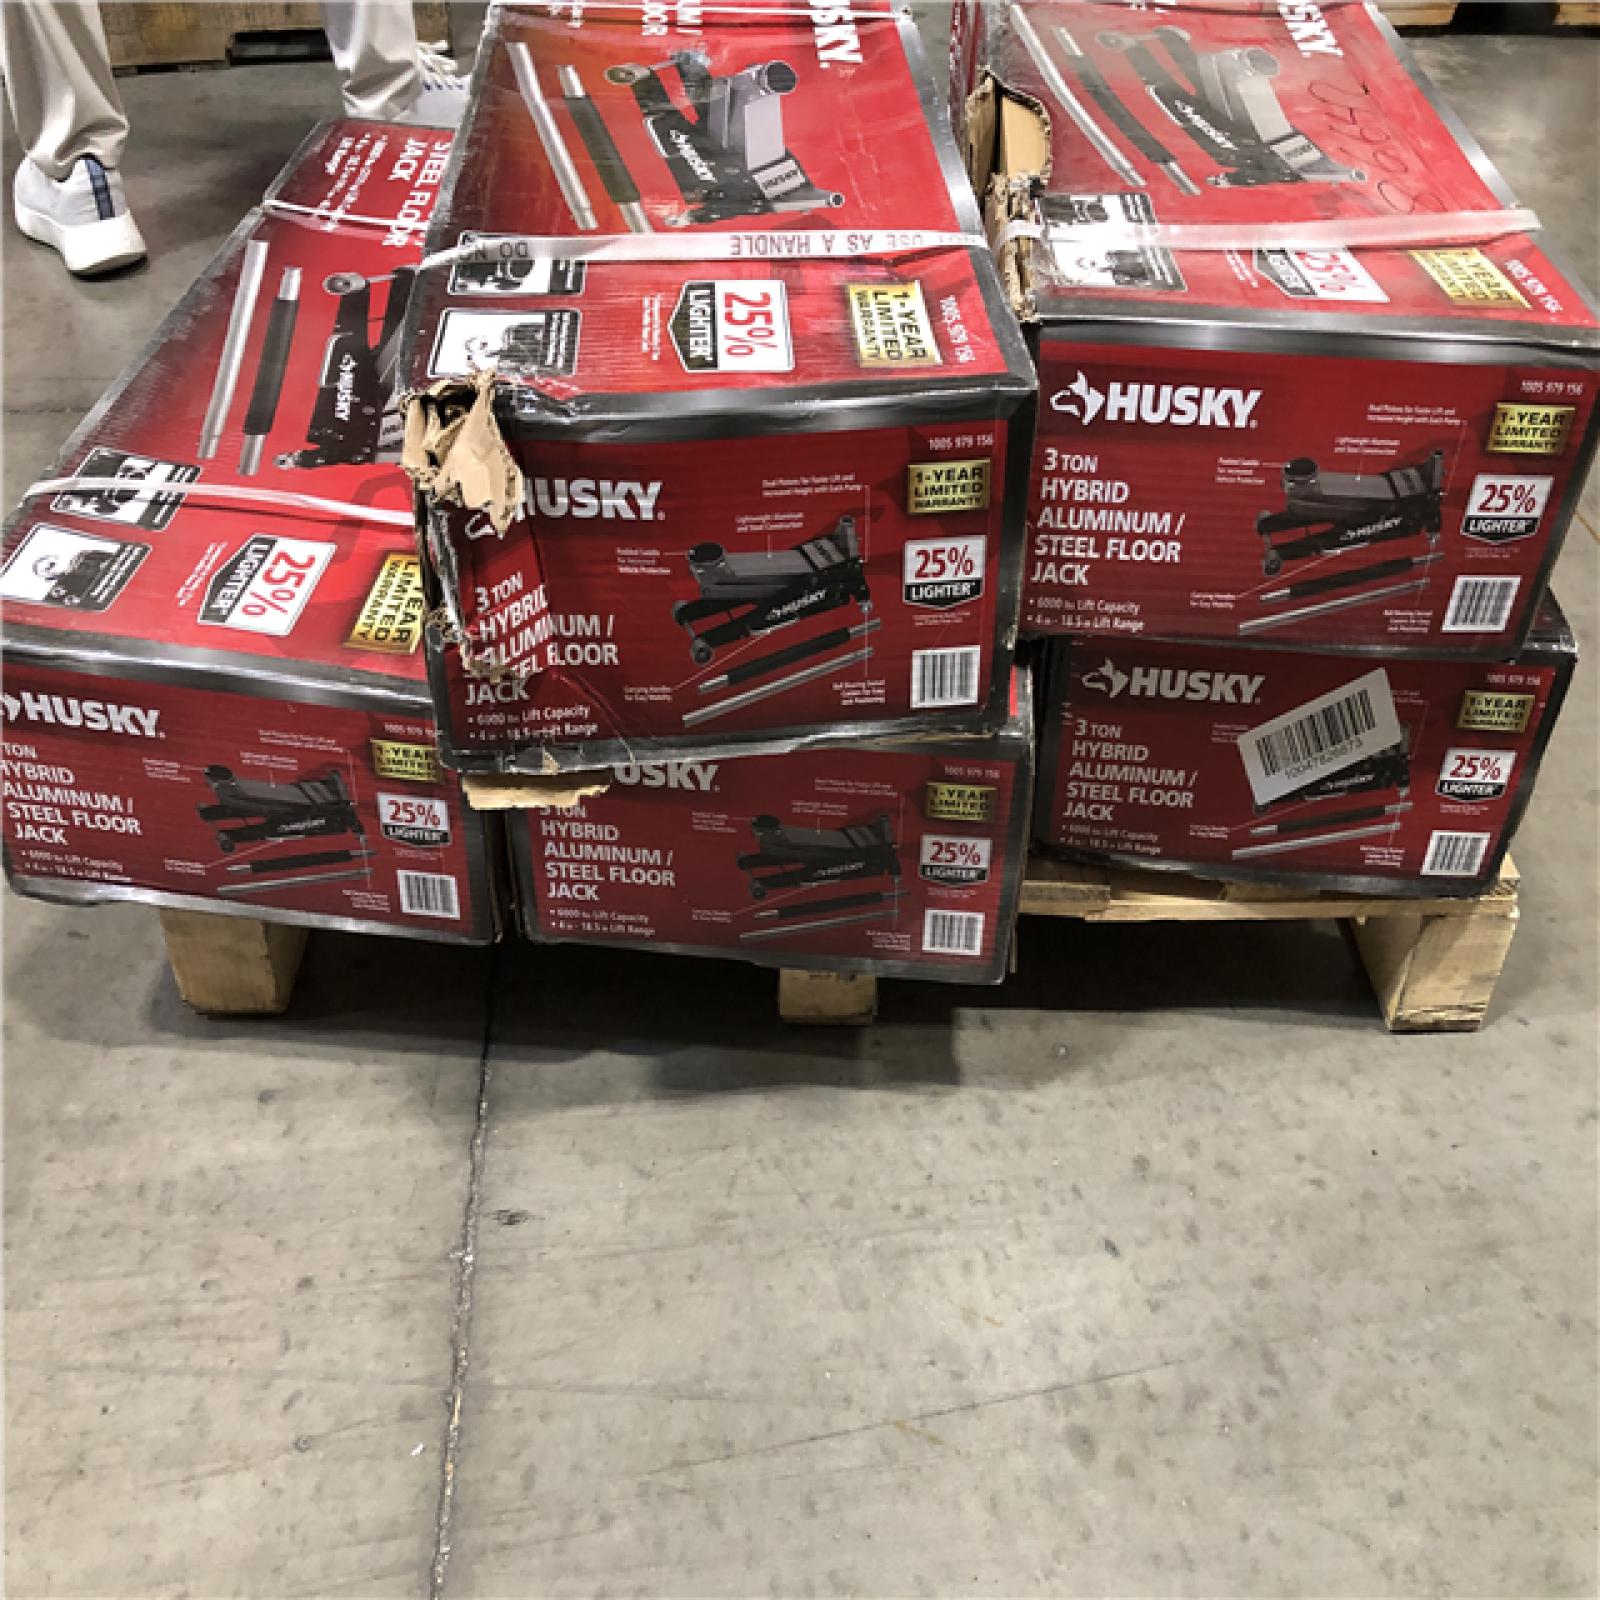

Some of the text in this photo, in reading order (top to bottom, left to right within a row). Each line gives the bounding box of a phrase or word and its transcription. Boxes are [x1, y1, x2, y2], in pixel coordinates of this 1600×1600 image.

[811, 0, 863, 61] SKY
[1278, 0, 1343, 56] SKY
[729, 234, 810, 256] HANDLE
[822, 234, 836, 253] A
[847, 233, 874, 252] AS
[689, 289, 713, 362] LIGHTER
[721, 291, 779, 357] 25%
[872, 290, 903, 362] LIMITED
[890, 290, 929, 361] 1-YEAR
[1105, 382, 1263, 428] HUSKY
[1499, 411, 1566, 426] 1-YEAR
[1495, 427, 1561, 438] LIMITED
[1044, 447, 1098, 472] 3 TON
[916, 467, 983, 484] 1-YEAR
[914, 482, 983, 498] LIMITED
[1040, 478, 1130, 502] HYBRID
[1477, 483, 1536, 513] 25%
[1037, 507, 1186, 535] ALUMINUM /
[1468, 518, 1528, 533] LIGHTER
[914, 544, 975, 578] 25%
[1034, 535, 1182, 563] STEEL FLOOR
[211, 538, 271, 616] LIGHTER
[242, 551, 317, 616] 25%
[1030, 562, 1091, 585] JACK
[475, 571, 523, 612] 3 TON
[911, 582, 971, 600] LIGHTER
[1077, 599, 1096, 610] Lift
[1097, 599, 1140, 615] Capacity
[607, 614, 615, 638] /
[1094, 617, 1111, 628] Lift
[1112, 617, 1146, 633] Range
[464, 682, 530, 705] JACK
[1129, 667, 1265, 703] HUSKY
[20, 691, 160, 738] HUSKY
[522, 709, 541, 722] Lift
[542, 704, 590, 720] Capacity
[565, 722, 598, 738] Range
[1075, 719, 1121, 738] 3 TON
[1072, 740, 1148, 761] HYBRID
[612, 761, 719, 792] USKY
[1069, 762, 1185, 786] ALUMINUM
[1450, 753, 1502, 780] 25%
[3, 782, 123, 813] ALUMINUM
[1067, 782, 1193, 808] STEEL FLOOR
[7, 802, 143, 836] STEEL FLOOR
[386, 799, 442, 828] 25%
[1062, 802, 1115, 821] JACK
[15, 822, 68, 846] JACK
[540, 820, 620, 841] HYBRID
[545, 841, 660, 866] ALUMINUM
[930, 839, 981, 865] 25%
[545, 862, 676, 888] STEEL FLOOR
[547, 882, 600, 901] JACK
[610, 912, 648, 925] Capacity
[627, 924, 656, 938] Range
